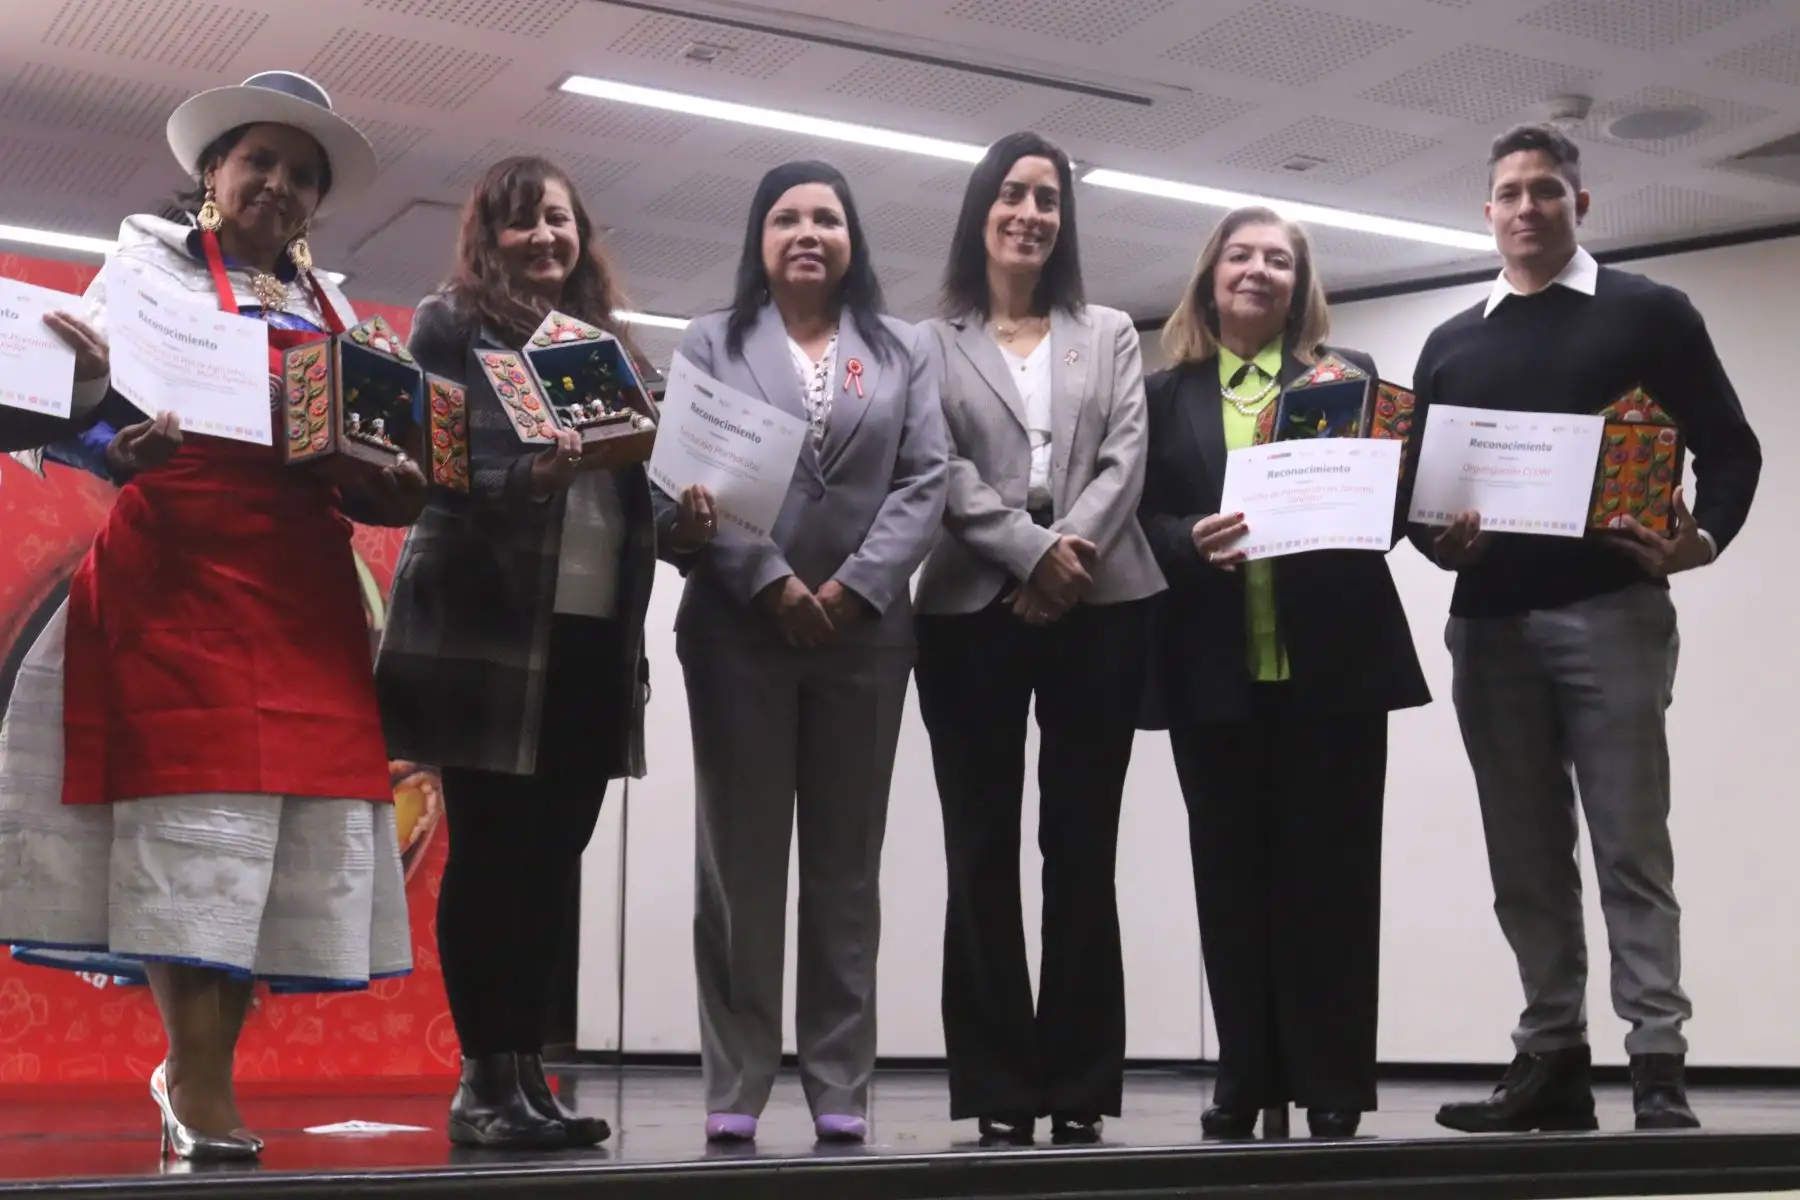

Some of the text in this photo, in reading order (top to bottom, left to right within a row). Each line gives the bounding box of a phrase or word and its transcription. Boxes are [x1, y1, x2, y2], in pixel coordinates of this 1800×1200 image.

[138, 309, 218, 350] Reconocimiento
[690, 401, 762, 444] Reconocimiento
[1469, 438, 1553, 452] Reconocimiento
[1267, 464, 1351, 480] Reconocimiento
